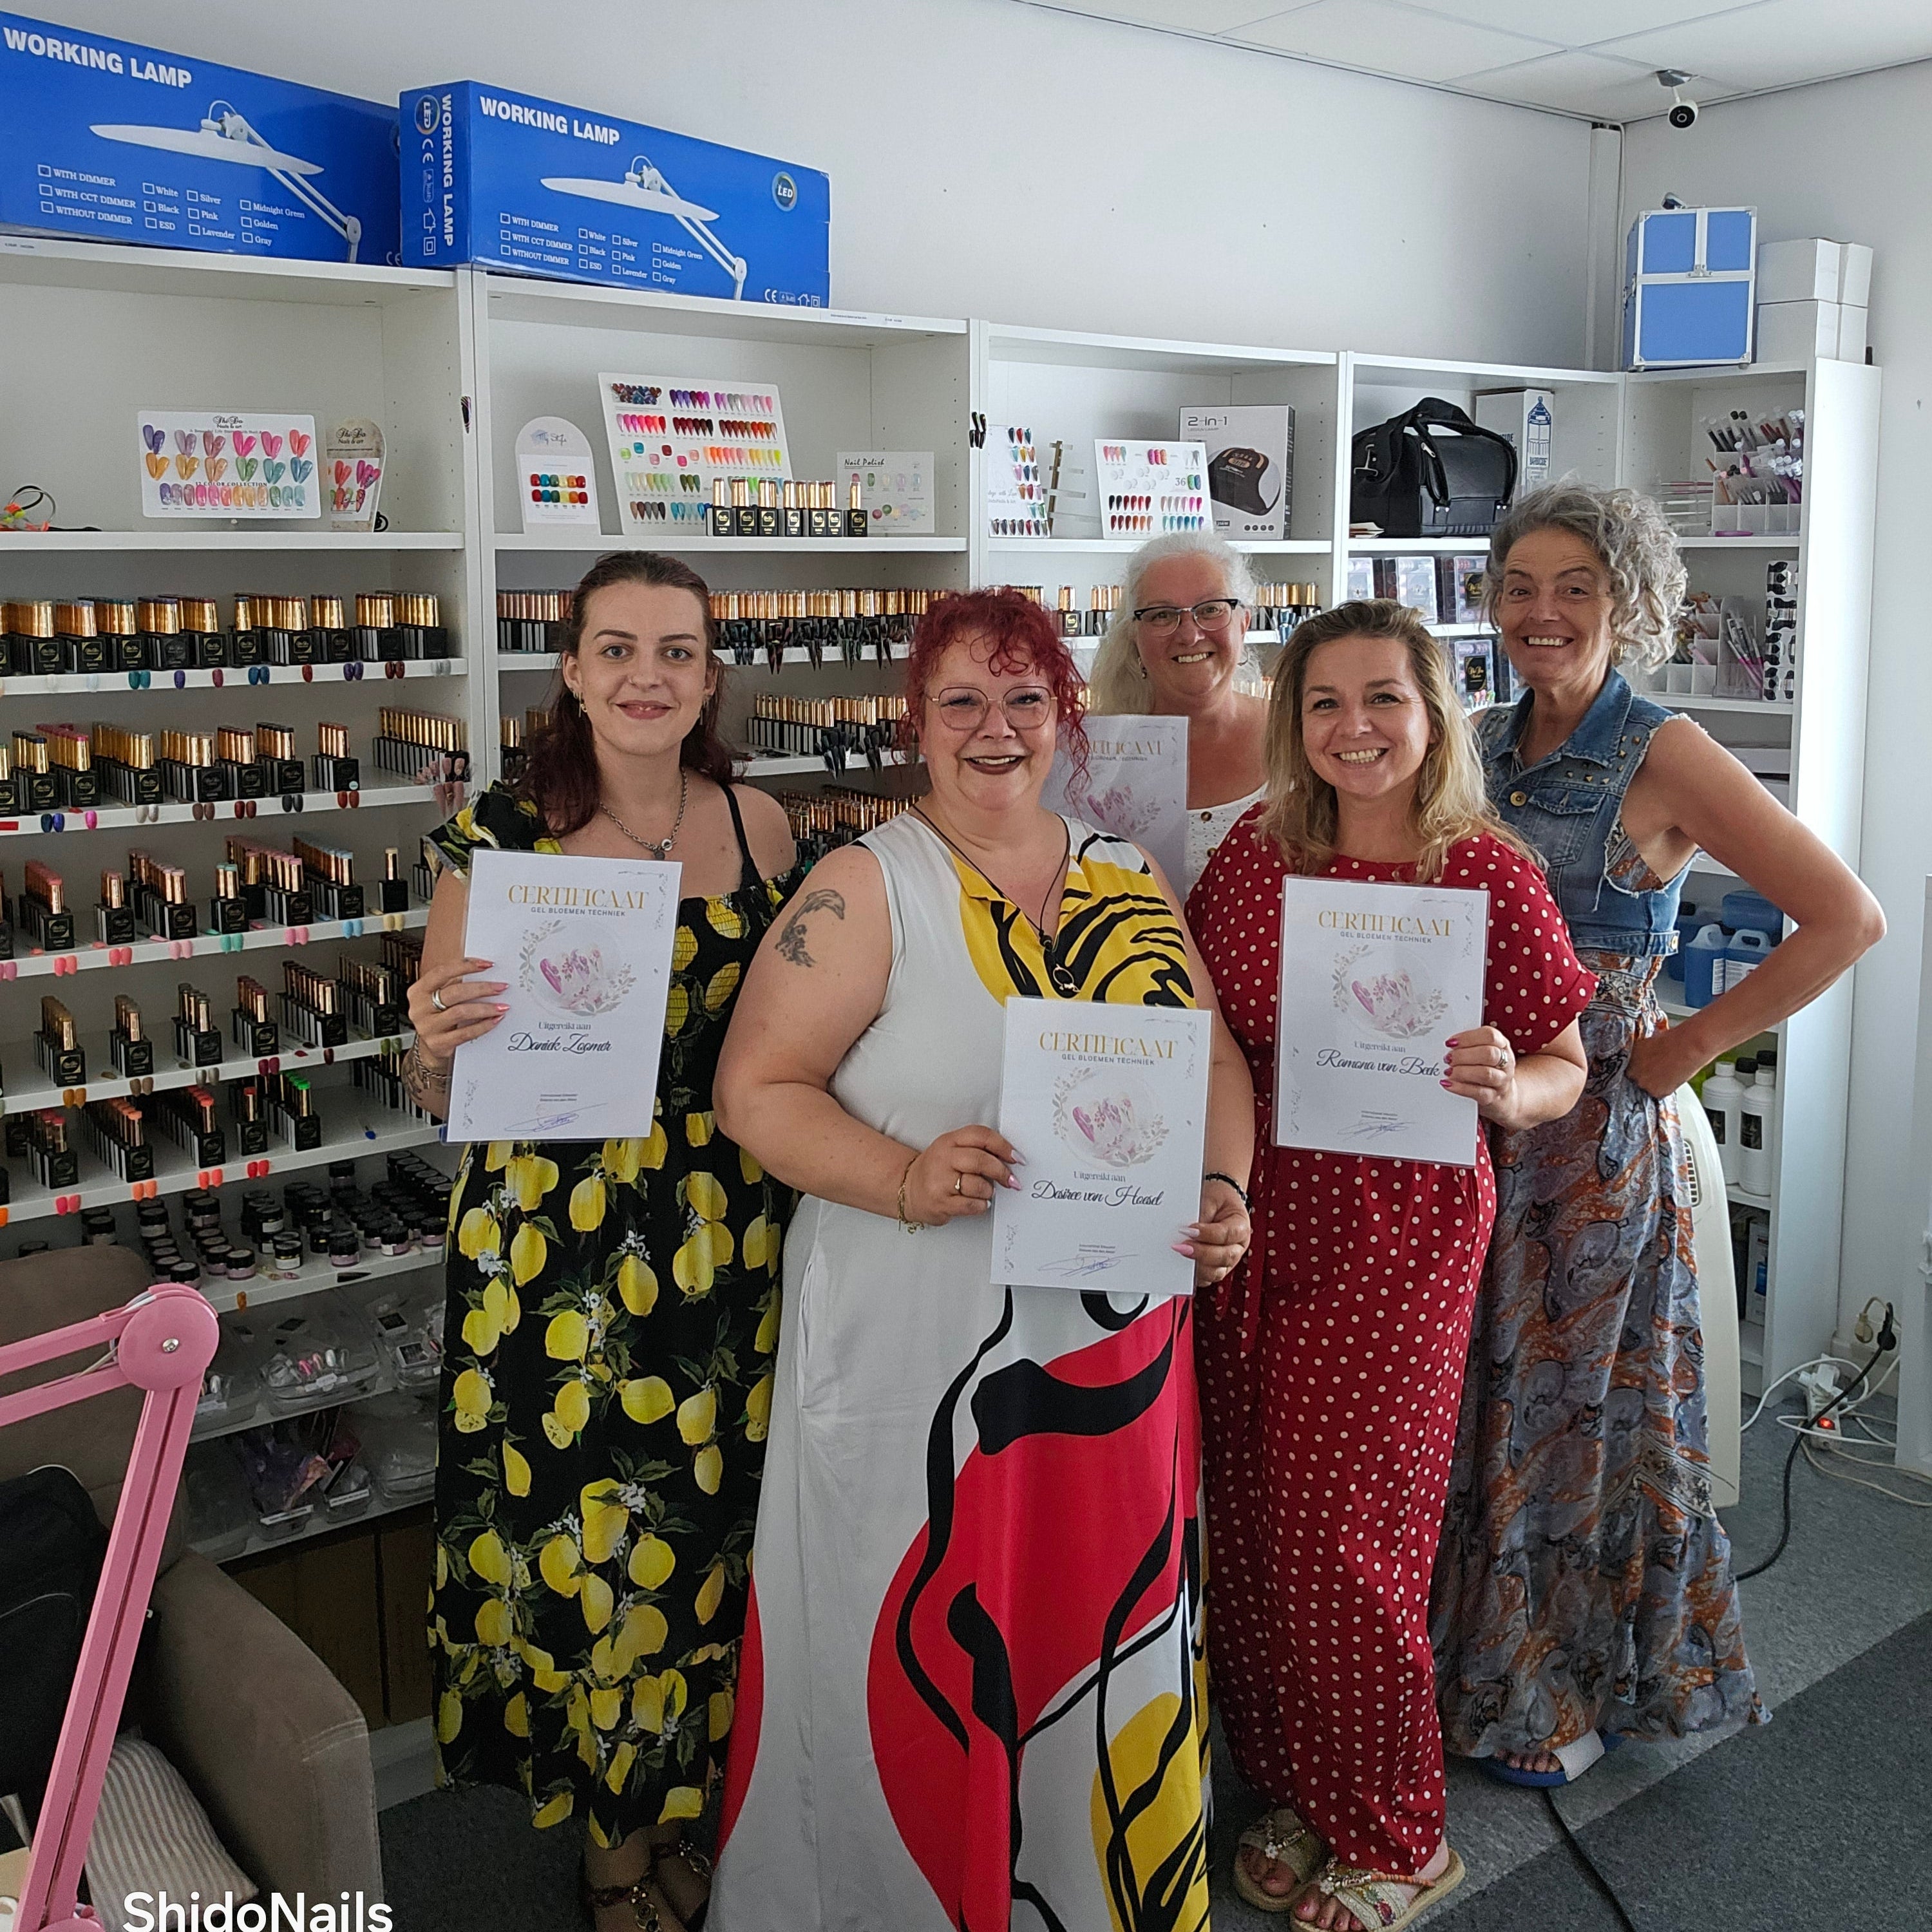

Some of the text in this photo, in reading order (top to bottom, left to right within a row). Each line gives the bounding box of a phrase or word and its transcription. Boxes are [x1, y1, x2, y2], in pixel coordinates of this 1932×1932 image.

[3, 27, 192, 89] WORKING LAMP
[480, 96, 620, 146] WORKING LAMP
[442, 94, 453, 247] WORKING LAMP
[53, 168, 116, 187] WITH DIMMER
[156, 185, 178, 198] White
[778, 185, 793, 198] LED
[55, 187, 137, 209] WITH CCT DIMMER
[200, 194, 221, 204] Silver
[158, 204, 180, 214] Black
[253, 203, 305, 218] Midnight Green
[56, 205, 133, 225] WITHOUT DIMMER
[201, 211, 218, 221] Pink
[159, 220, 176, 230] ESD
[254, 220, 278, 230] Golden
[512, 216, 559, 232] WITH DIMMER
[202, 227, 236, 240] Lavender
[589, 231, 606, 242] White
[254, 236, 272, 246] Gray
[512, 233, 573, 251] WITH CCT DIMMER
[622, 238, 638, 247] Silver
[589, 246, 606, 256] Black
[622, 252, 636, 261] Pink
[663, 246, 703, 260] Midnight Green
[512, 249, 569, 265] WITHOUT DIMMER
[589, 261, 602, 270] ESD
[663, 260, 682, 270] Golden
[622, 267, 648, 279] Lavender
[663, 275, 676, 285] Gray
[1188, 416, 1227, 426] 2-in-1
[1175, 478, 1186, 486] 36
[507, 884, 649, 910] CERTIFICAAT
[548, 907, 586, 915] BLOEMEN
[588, 909, 626, 917] TECHNIEK
[1318, 910, 1455, 936] CERTIFICAAT
[1356, 932, 1392, 941] BLOEMEN
[1394, 934, 1433, 943] TECHNIEK
[1039, 1032, 1179, 1059] CERTIFICAAT
[1078, 1055, 1115, 1063] BLOEMEN
[1117, 1057, 1155, 1066] TECHNIEK
[1316, 1048, 1376, 1072] Ramona
[1376, 1063, 1398, 1072] van
[1083, 1191, 1104, 1202] van
